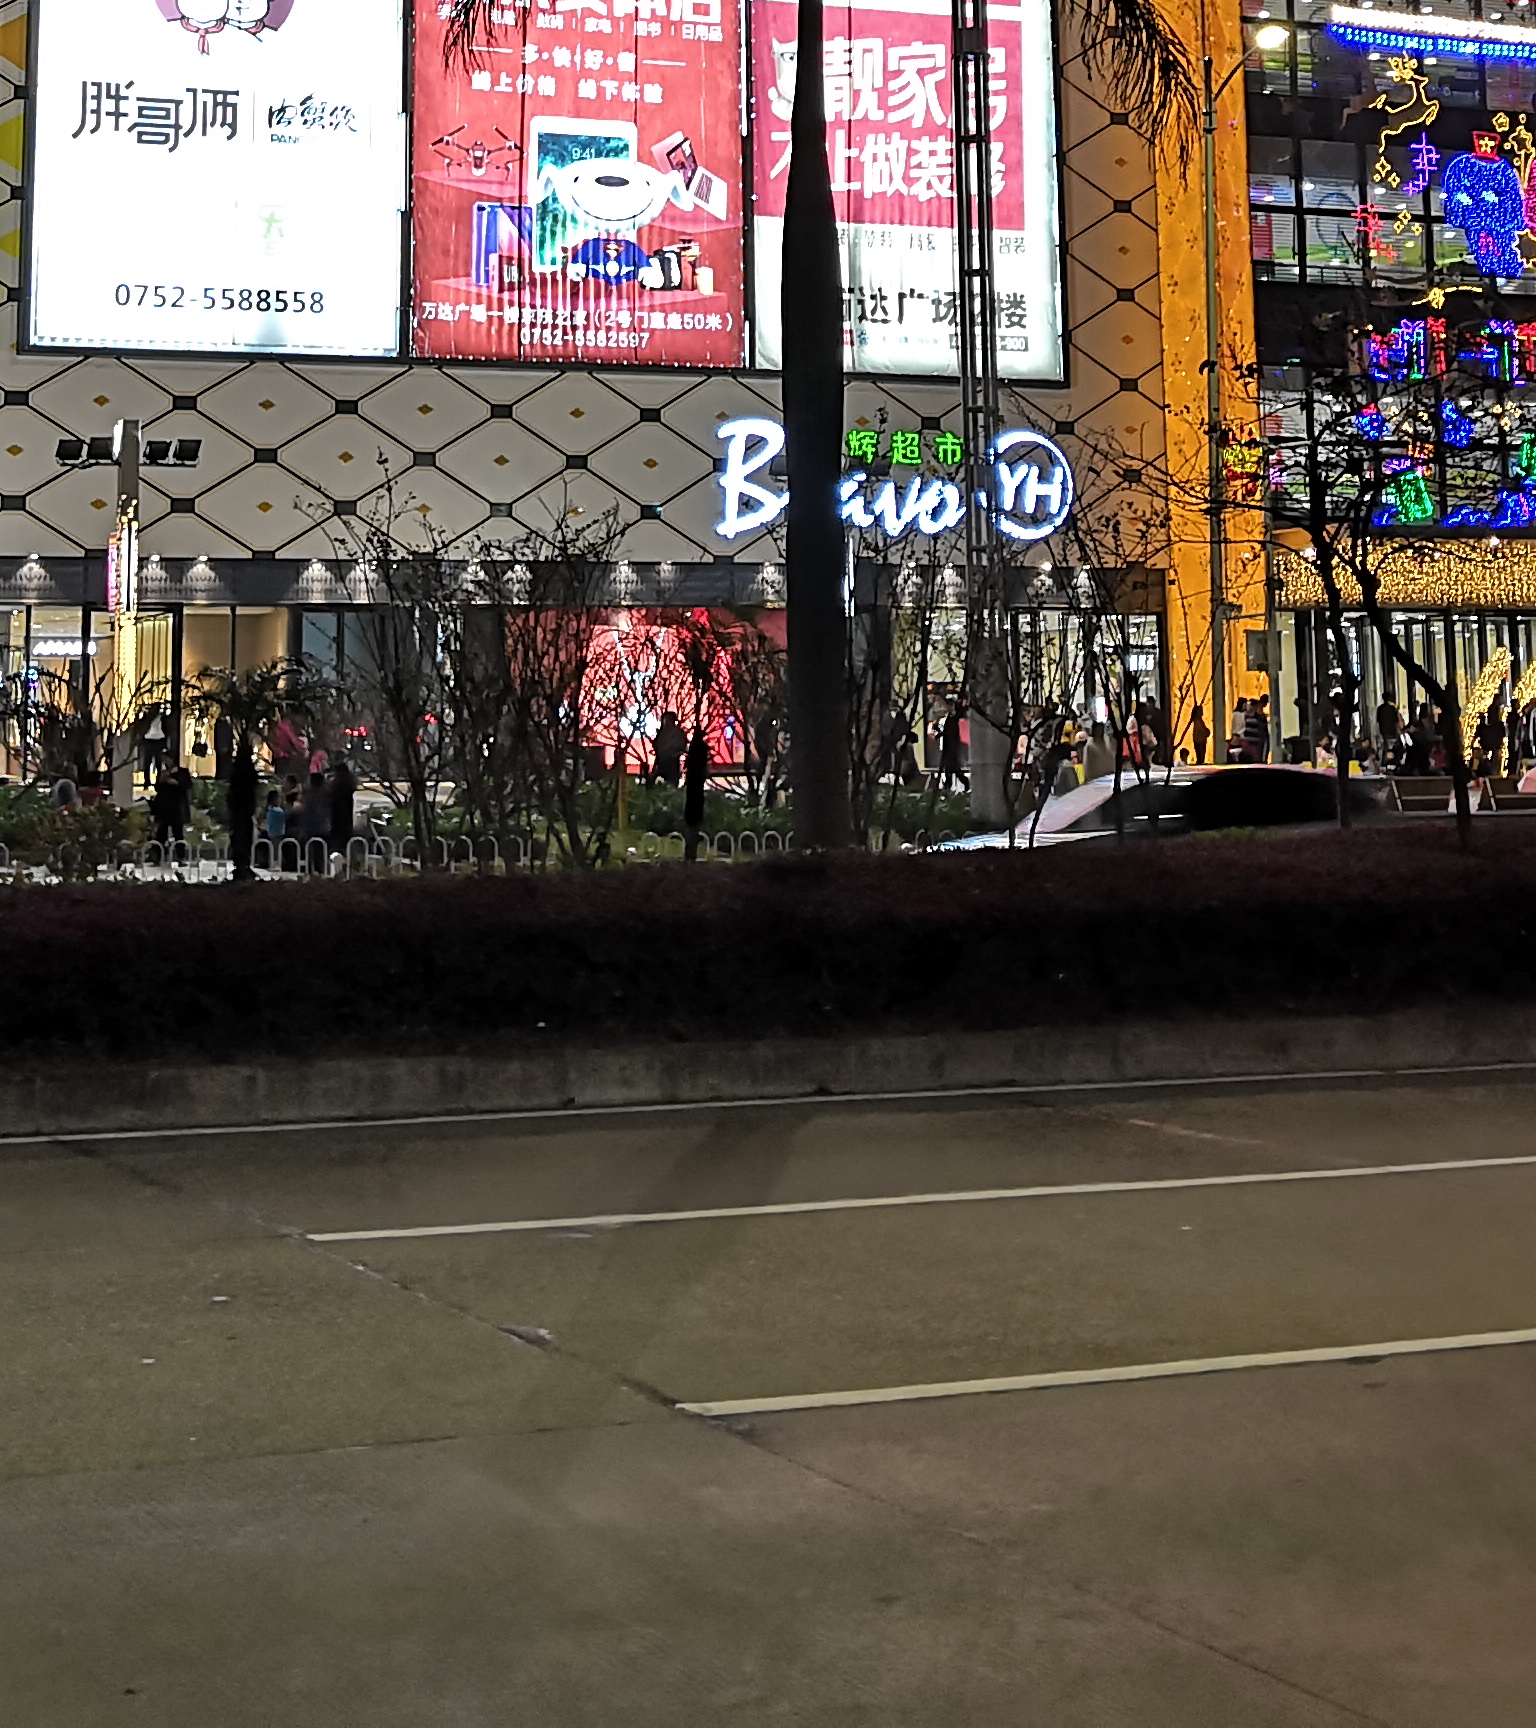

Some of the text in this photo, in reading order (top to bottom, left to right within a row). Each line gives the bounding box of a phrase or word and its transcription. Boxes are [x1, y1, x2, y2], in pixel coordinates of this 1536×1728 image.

[681, 24, 723, 42] 日用品
[72, 80, 240, 153] 胖哥俩
[571, 147, 596, 160] 9:41
[115, 284, 324, 313] 0752-5588558
[846, 429, 965, 467] 辉超市
[715, 418, 967, 540] Bvo
